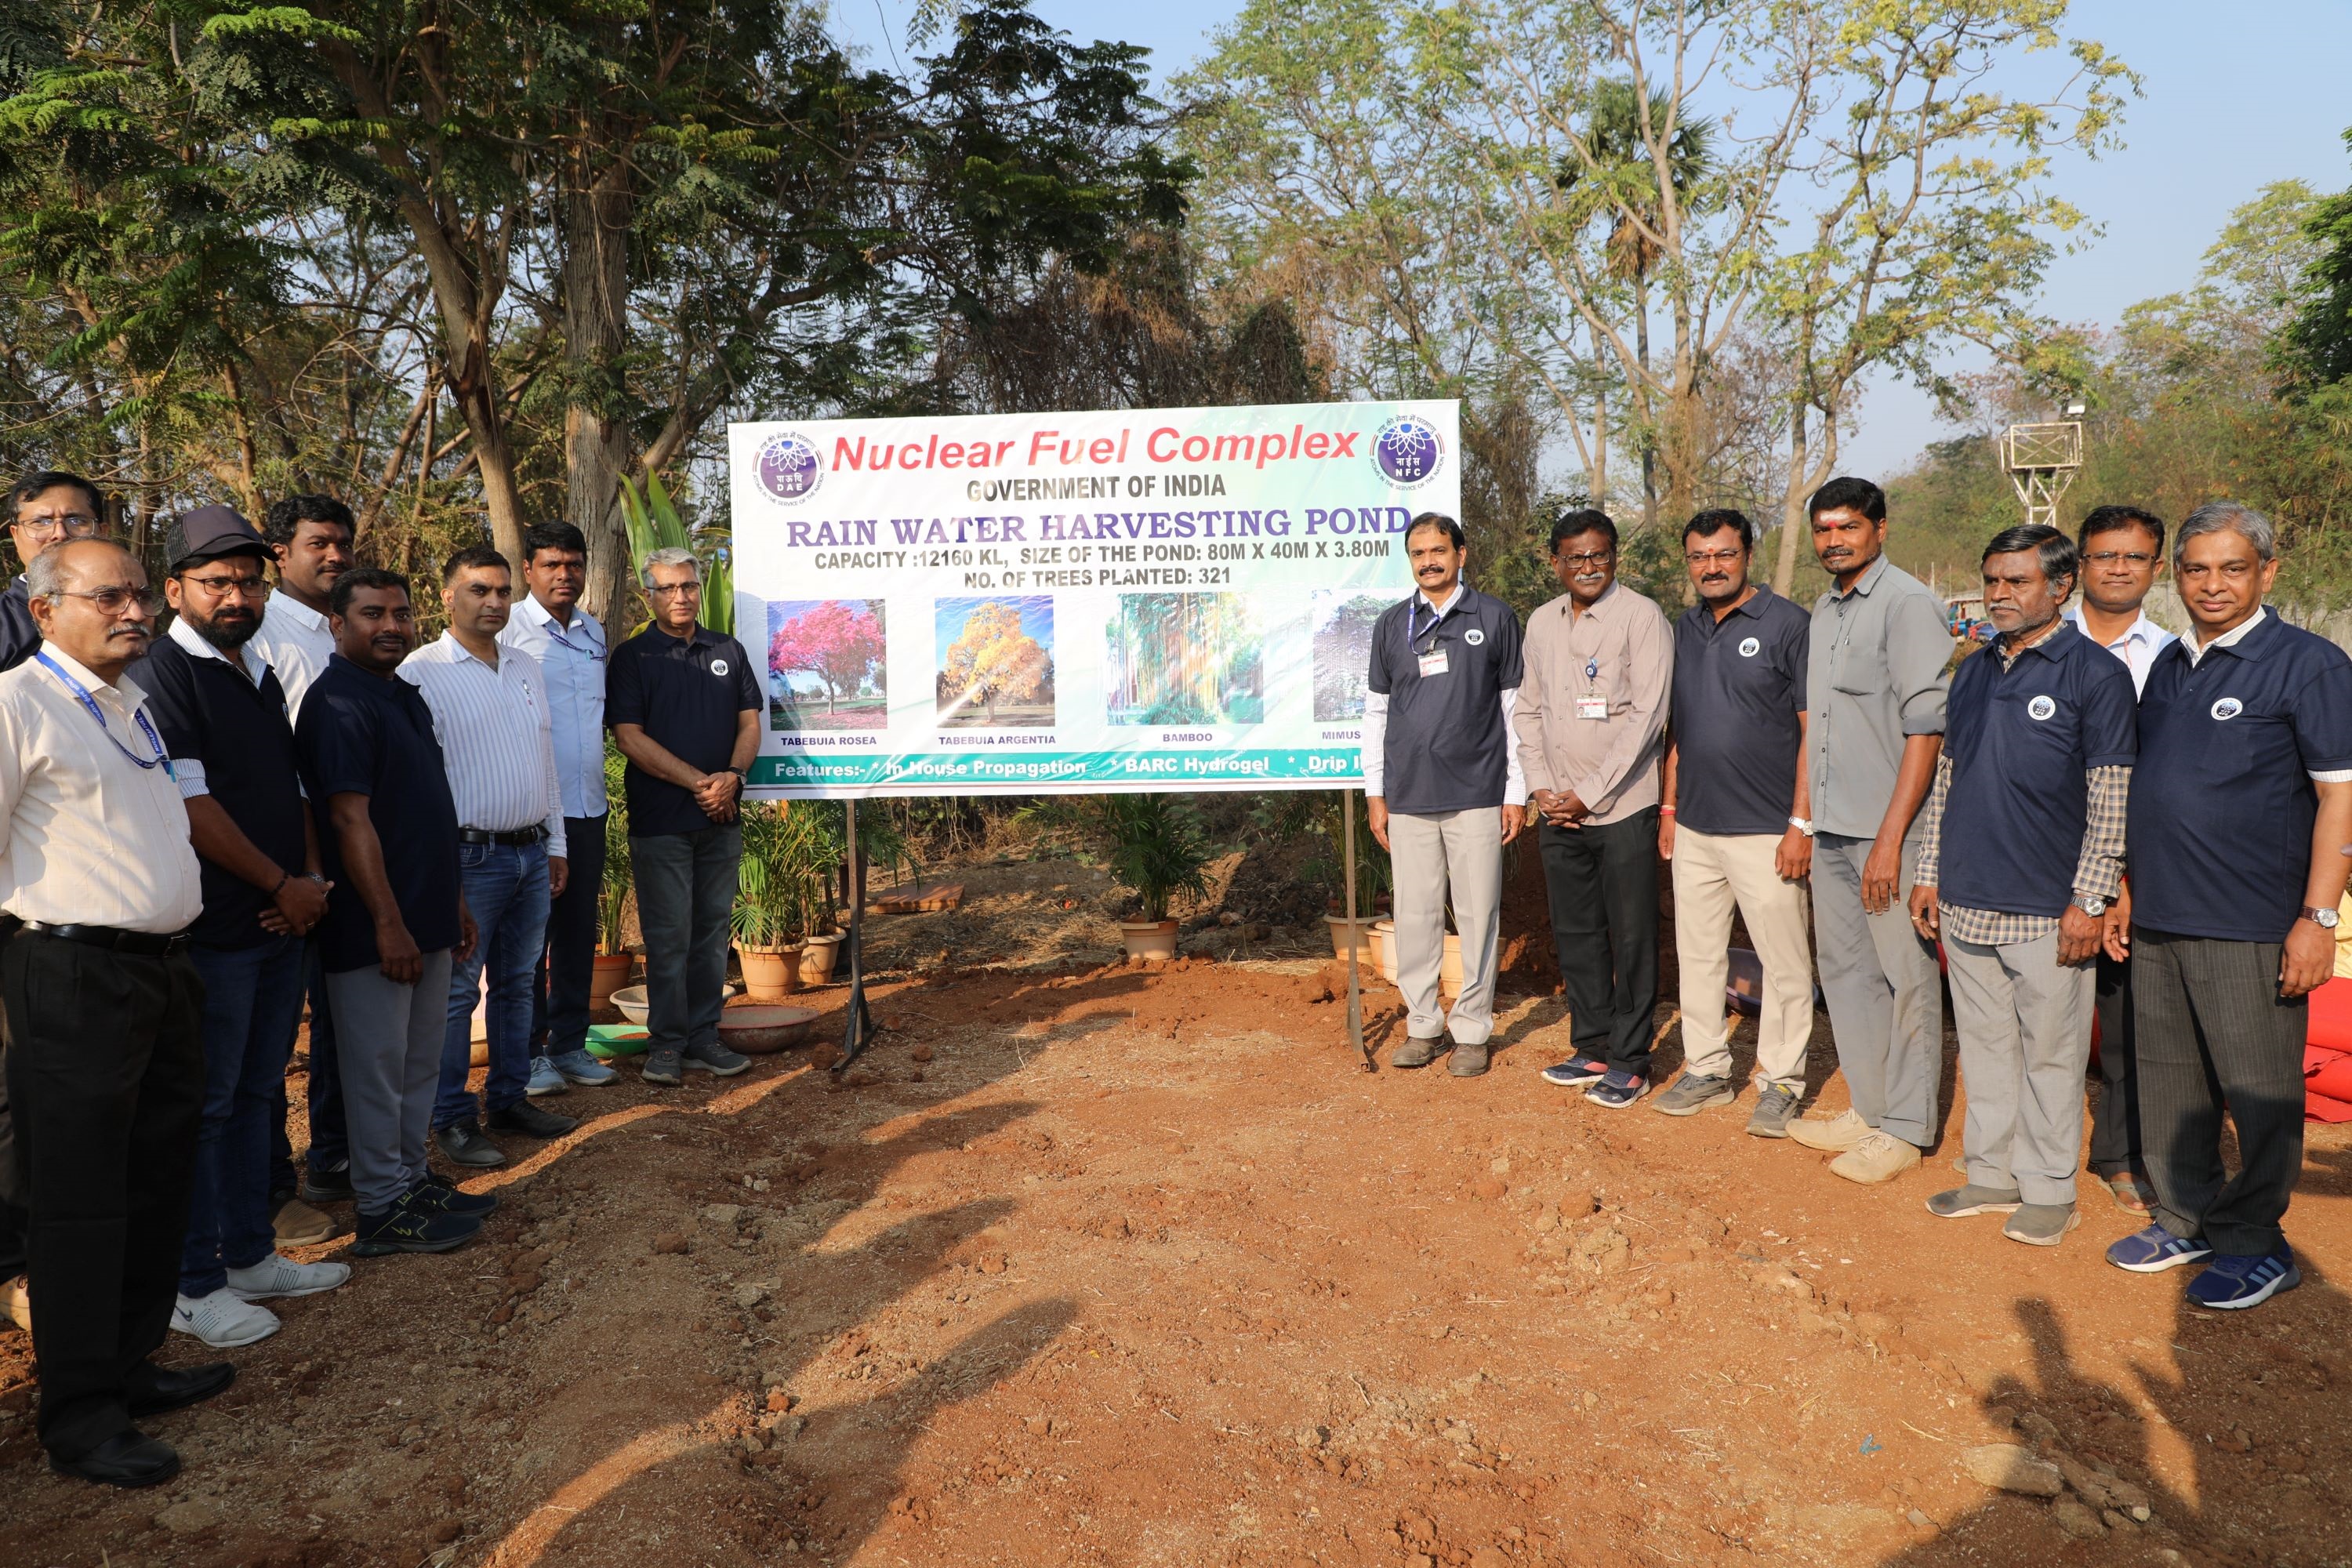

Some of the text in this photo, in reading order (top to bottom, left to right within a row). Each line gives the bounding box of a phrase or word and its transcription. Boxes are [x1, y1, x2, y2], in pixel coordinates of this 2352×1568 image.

[832, 424, 1360, 471] Nuclear Fuel Complex
[1385, 480, 1395, 488] THE
[1425, 475, 1435, 485] THE
[1433, 456, 1445, 476] NATION
[967, 474, 1226, 502] GOVERNMENT OF INDIA
[786, 506, 1411, 547] RAIN WATER HARVESTING POND
[815, 551, 906, 569] CAPACITY
[979, 549, 1008, 568] KL,
[1020, 547, 1062, 564] SIZE
[1068, 546, 1092, 564] OF
[1098, 545, 1136, 562] THE
[1143, 544, 1201, 561] POND:
[1207, 543, 1245, 561] 80M
[1252, 543, 1265, 560] X
[1270, 542, 1308, 559] 40M
[1315, 541, 1328, 558] X
[1334, 540, 1389, 557] 3.80M
[964, 567, 1230, 589] NO. OF TREES PLANTED: 321
[781, 736, 877, 746] TABEBUIA ROSEA
[938, 735, 1056, 745] TABEBUIA ARGENTIA
[1163, 733, 1213, 742] BAMBOO
[1322, 731, 1361, 739] MIMUS
[775, 763, 866, 777] Features:-
[908, 760, 967, 775] House
[973, 760, 1087, 778] Propagation
[1125, 757, 1269, 775] BARC Hydrogel
[1308, 755, 1348, 773] Drip
